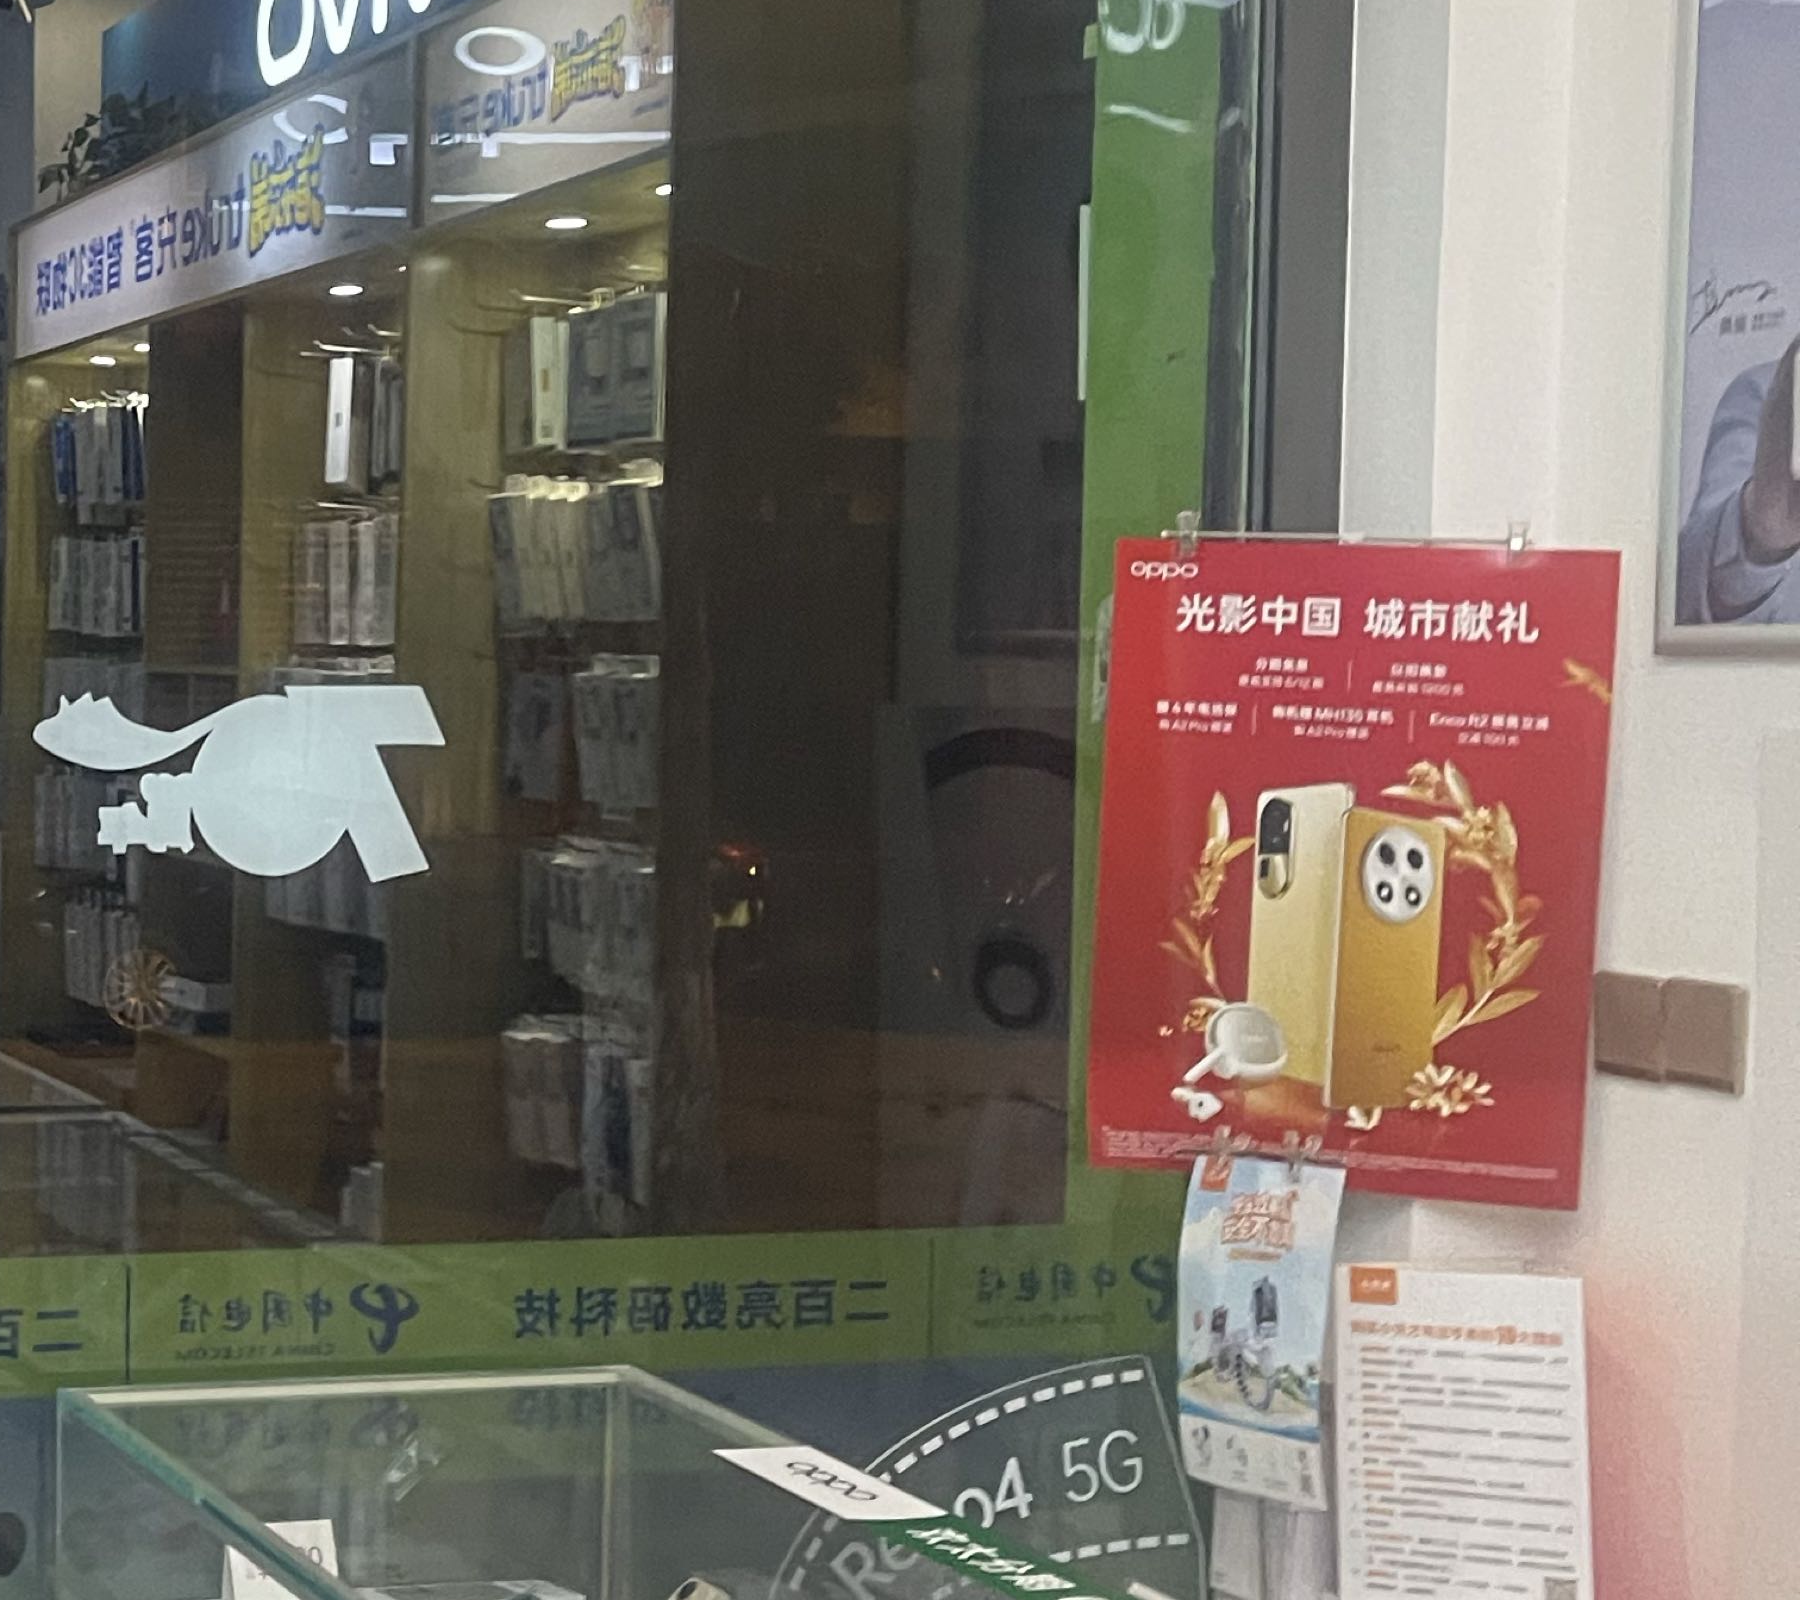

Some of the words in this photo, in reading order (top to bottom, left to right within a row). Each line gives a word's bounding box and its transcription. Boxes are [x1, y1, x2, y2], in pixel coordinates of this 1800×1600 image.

[1131, 560, 1198, 582] oppo
[1177, 594, 1341, 638] 光影中国
[1364, 597, 1540, 643] 城市献礼
[1062, 1429, 1144, 1503] 5G
